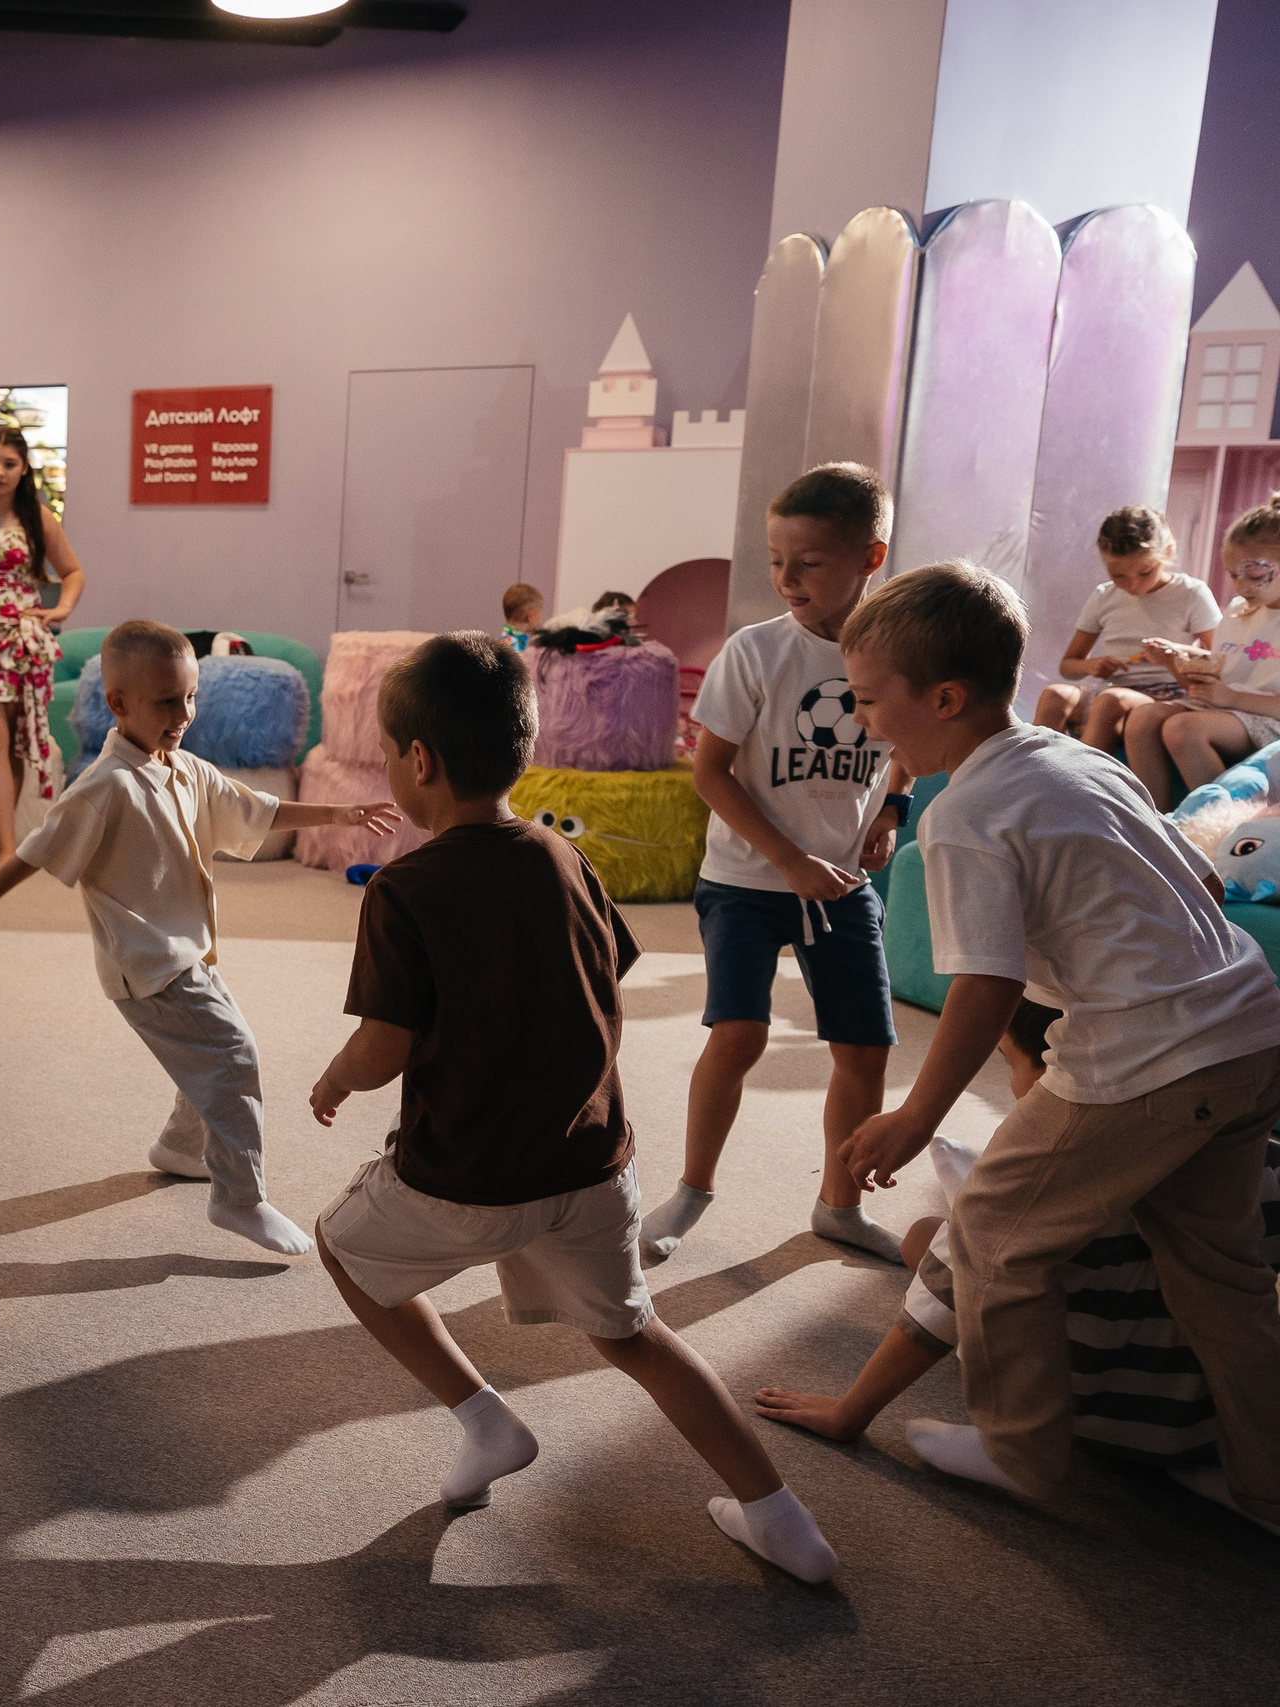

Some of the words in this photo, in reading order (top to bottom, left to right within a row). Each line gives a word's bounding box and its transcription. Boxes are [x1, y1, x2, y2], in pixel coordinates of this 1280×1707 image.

[145, 408, 214, 427] Детский
[217, 406, 261, 426] Лофт
[144, 443, 159, 454] VR
[159, 444, 194, 456] games
[212, 442, 259, 454] Караоке
[144, 457, 198, 470] PlayStation
[144, 472, 163, 483] Just
[164, 472, 198, 483] Dance
[211, 471, 249, 484] Мафия
[771, 747, 881, 788] LEAGUE
